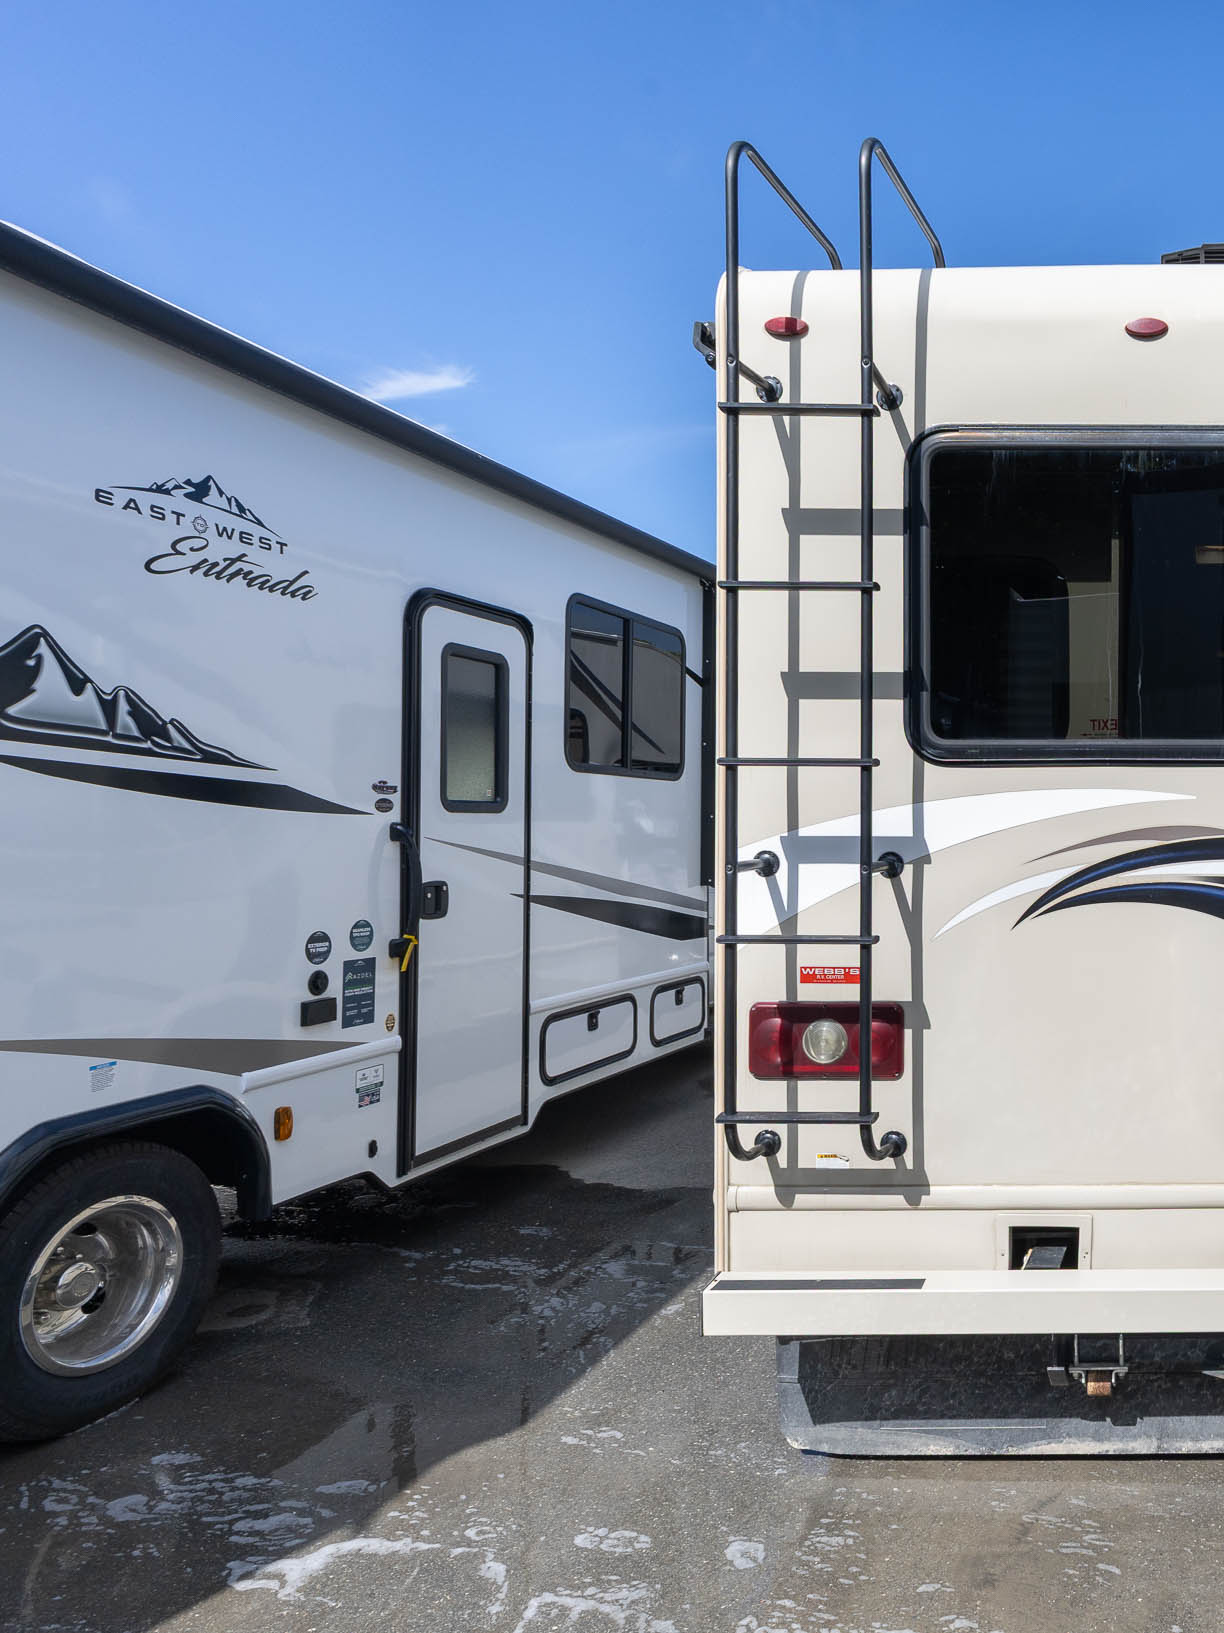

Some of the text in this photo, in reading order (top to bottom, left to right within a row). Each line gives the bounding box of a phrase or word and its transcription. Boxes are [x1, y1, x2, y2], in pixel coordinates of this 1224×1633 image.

[94, 488, 186, 525] EAST
[214, 522, 288, 555] WEST
[144, 535, 319, 601] Entrada
